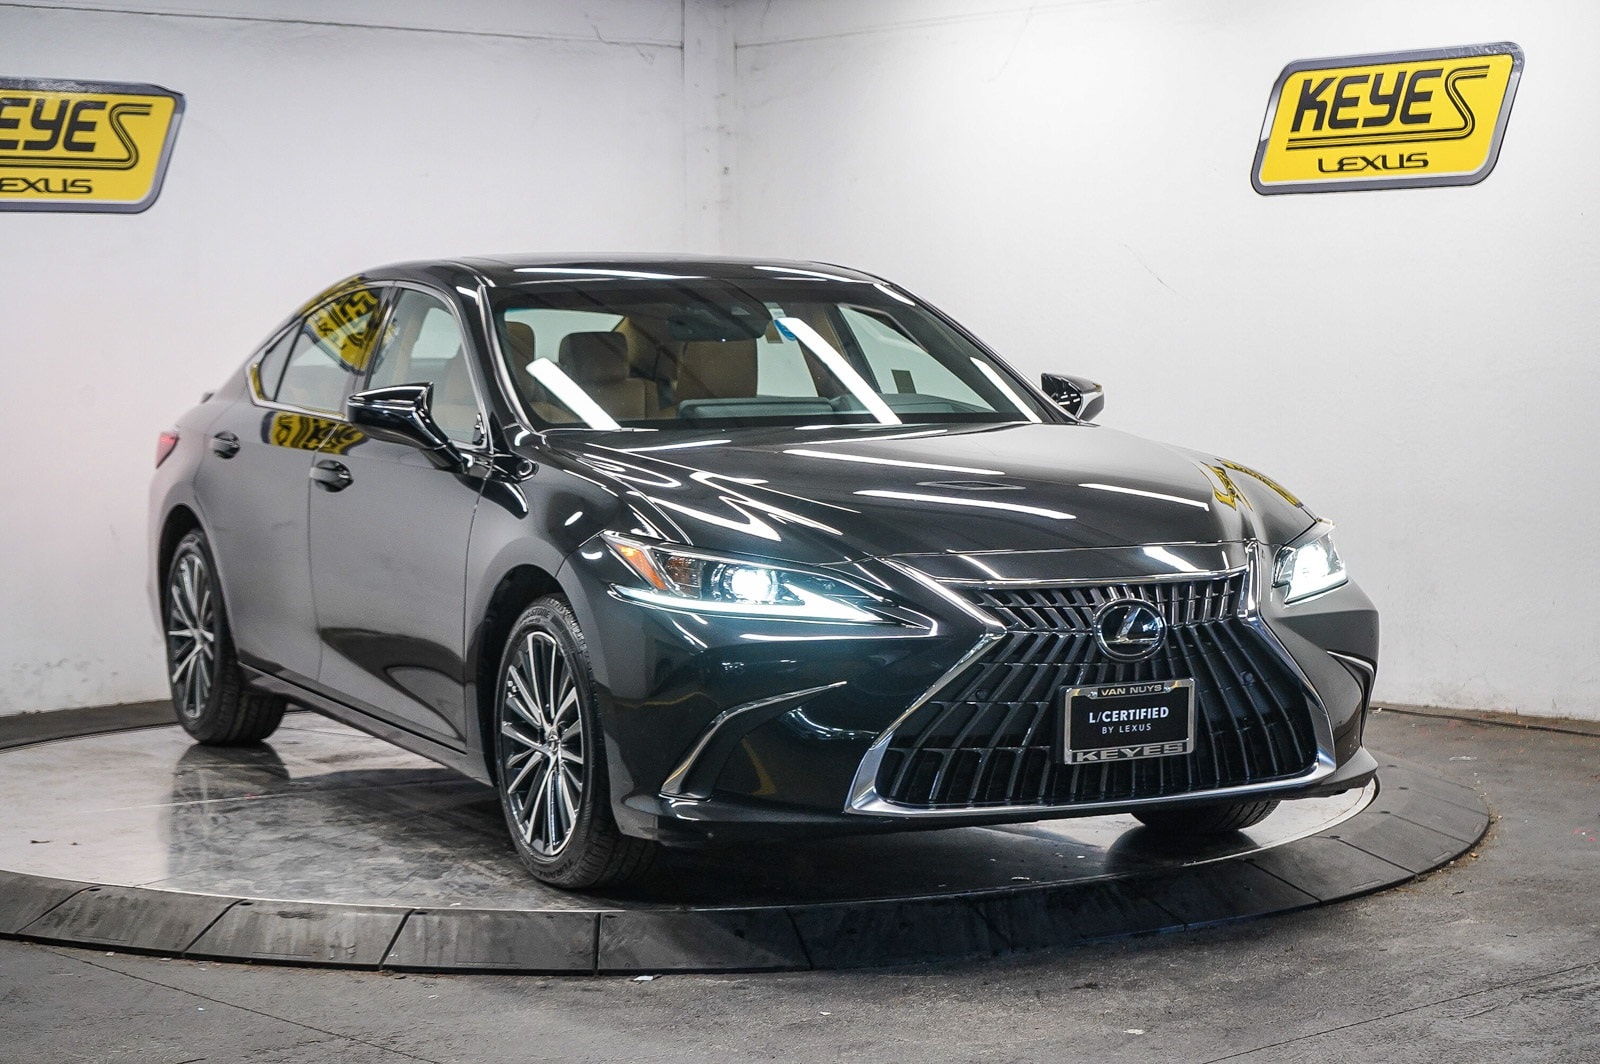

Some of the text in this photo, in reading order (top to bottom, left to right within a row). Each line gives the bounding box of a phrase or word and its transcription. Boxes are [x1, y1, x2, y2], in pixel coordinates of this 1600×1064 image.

[1286, 65, 1490, 150] KEYES
[1318, 152, 1429, 173] LEXUS
[1101, 684, 1162, 696] VAN NUYS
[1089, 706, 1169, 723] L/CERTIFIED
[1102, 723, 1152, 735] BY LEXUS
[1076, 742, 1183, 762] KEYES
